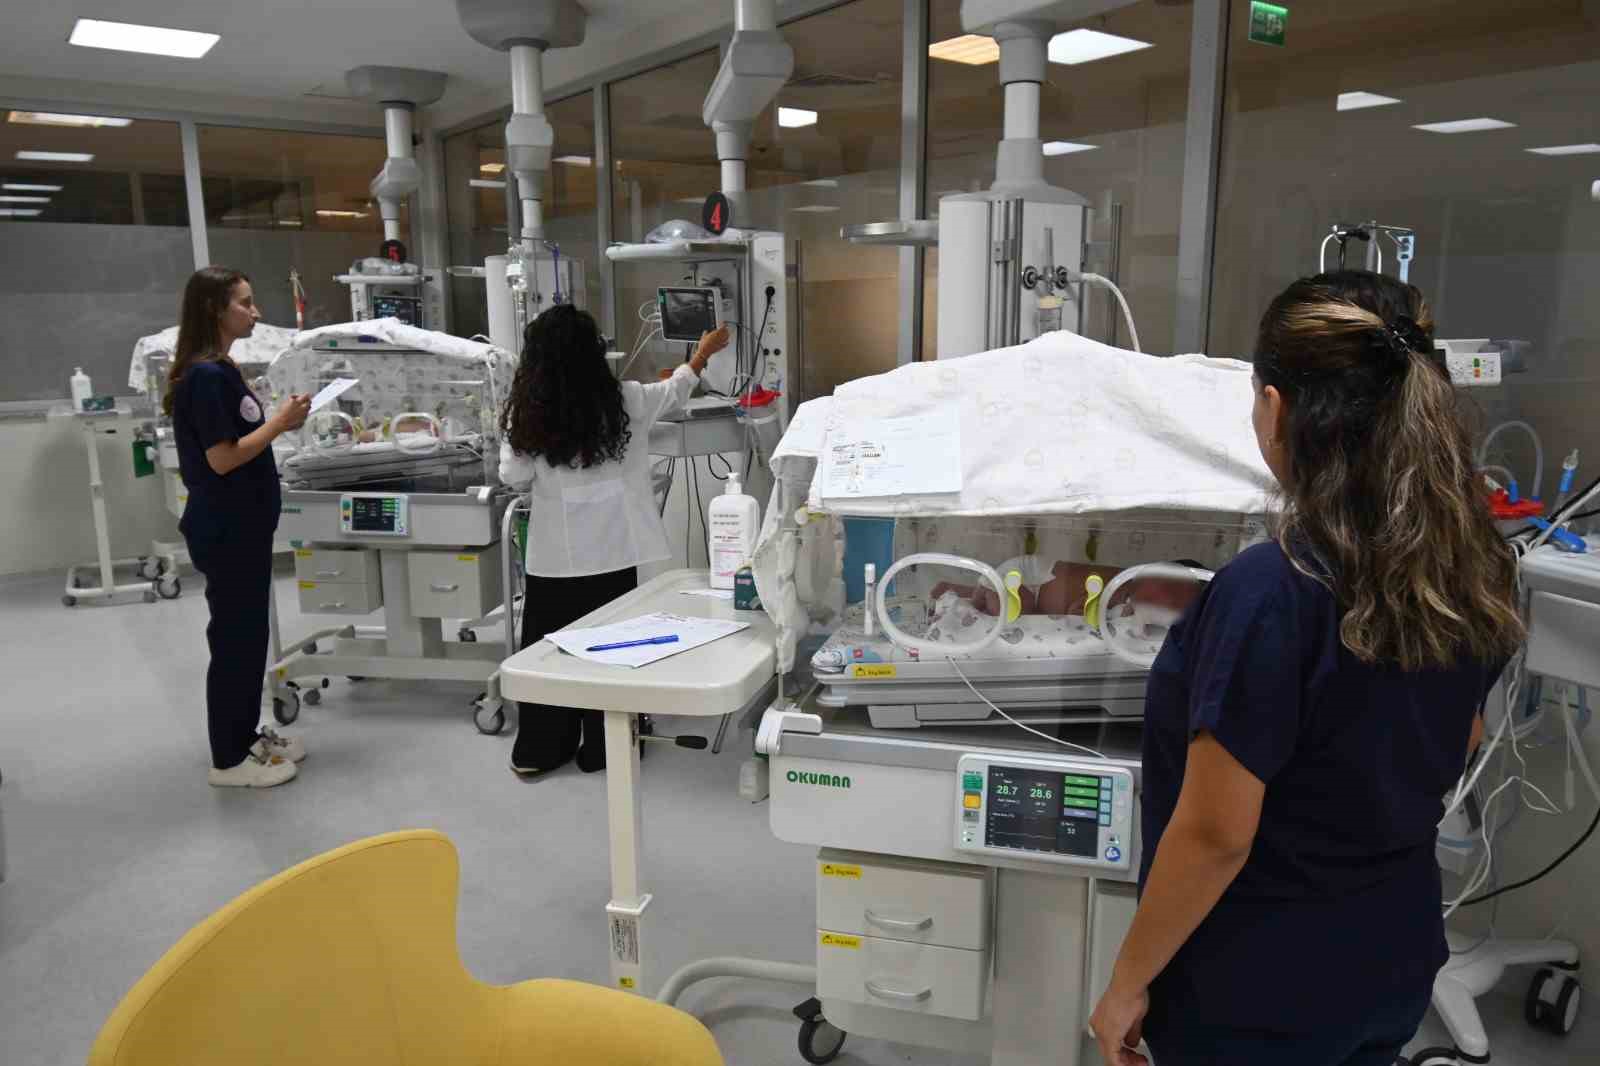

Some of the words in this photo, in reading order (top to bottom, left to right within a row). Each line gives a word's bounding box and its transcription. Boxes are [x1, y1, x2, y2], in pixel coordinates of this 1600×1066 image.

[710, 201, 721, 231] 4
[786, 770, 851, 789] OKUMAN
[995, 784, 1018, 795] 28.7
[1029, 788, 1053, 799] 28.6
